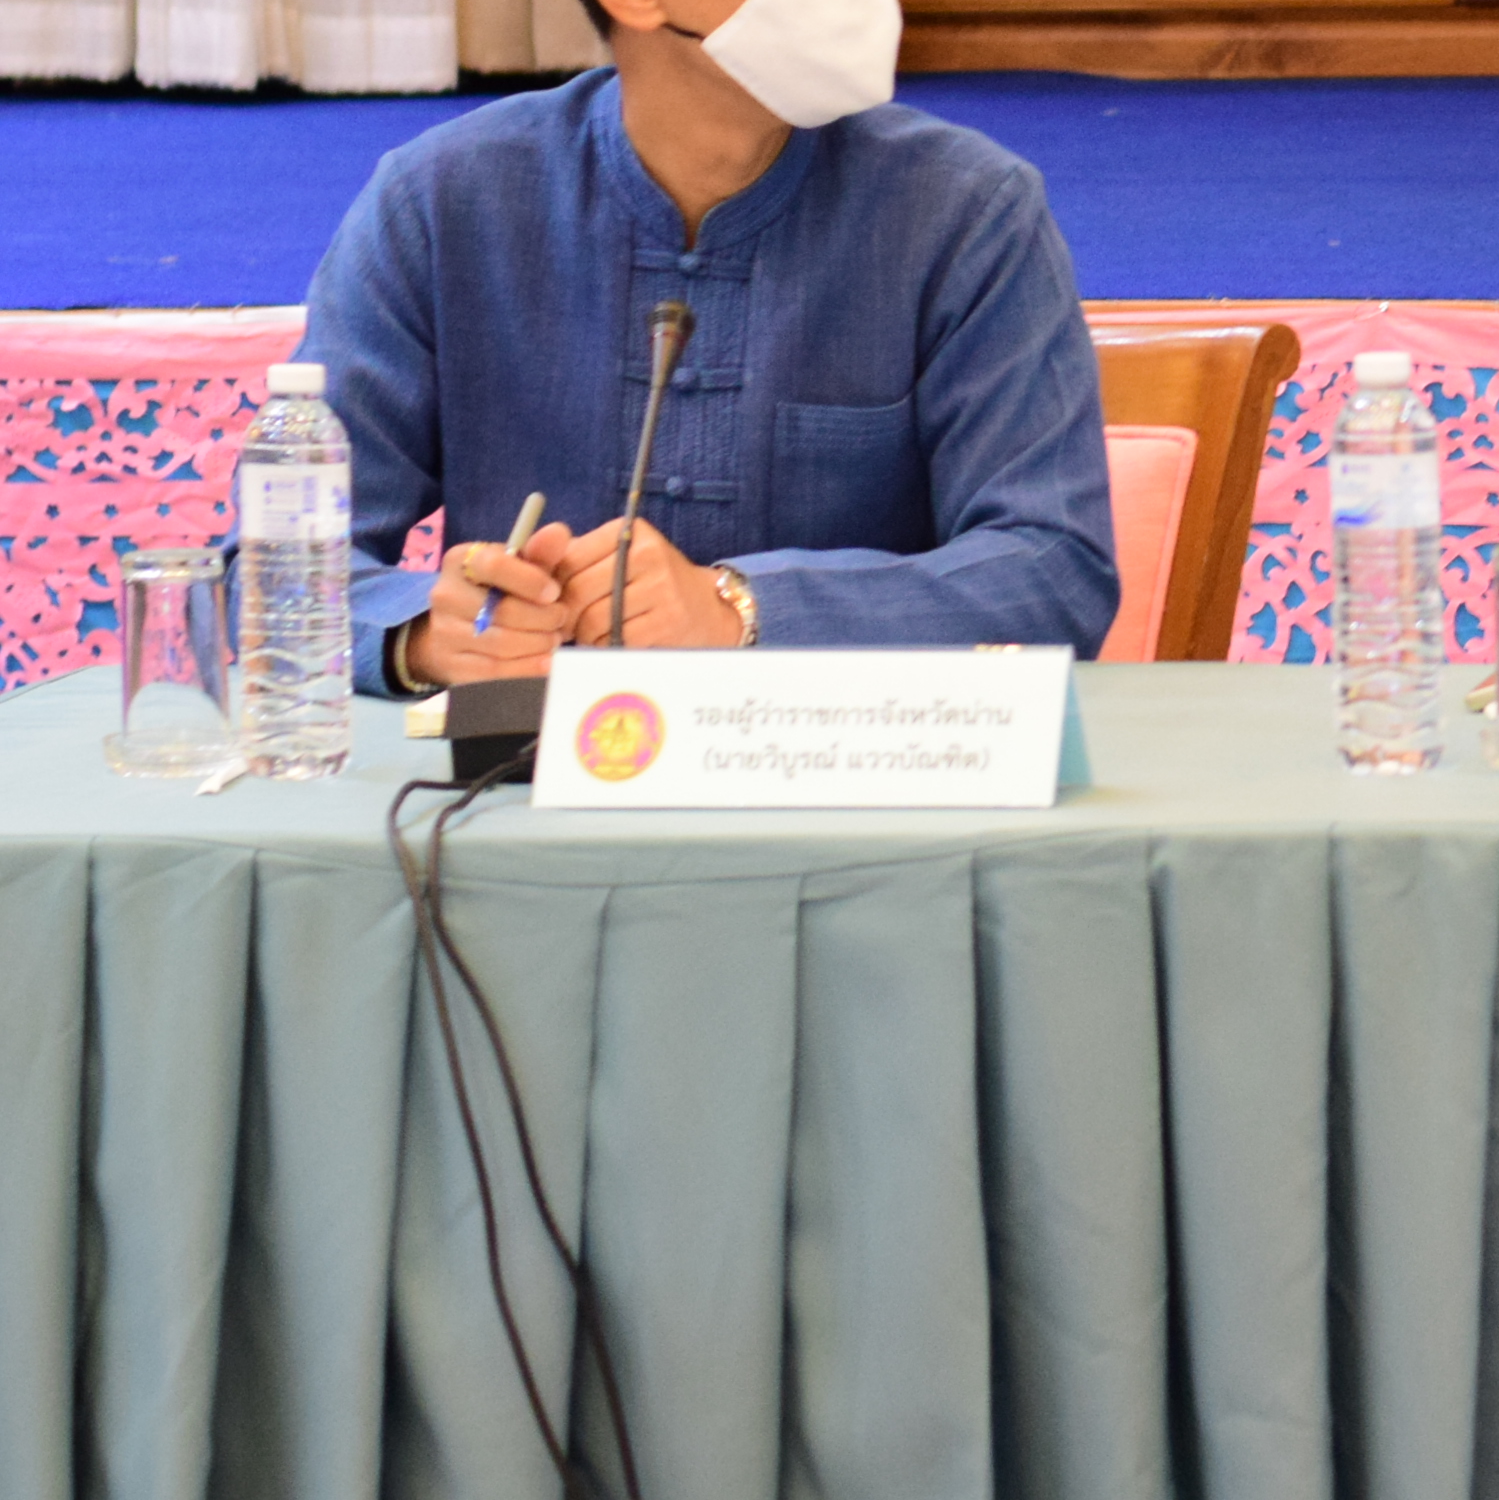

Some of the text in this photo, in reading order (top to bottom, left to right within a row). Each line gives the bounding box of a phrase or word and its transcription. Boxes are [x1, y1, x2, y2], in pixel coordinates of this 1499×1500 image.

[691, 696, 1014, 735] รองผู้ว่าราชการจังหวัดน่าน
